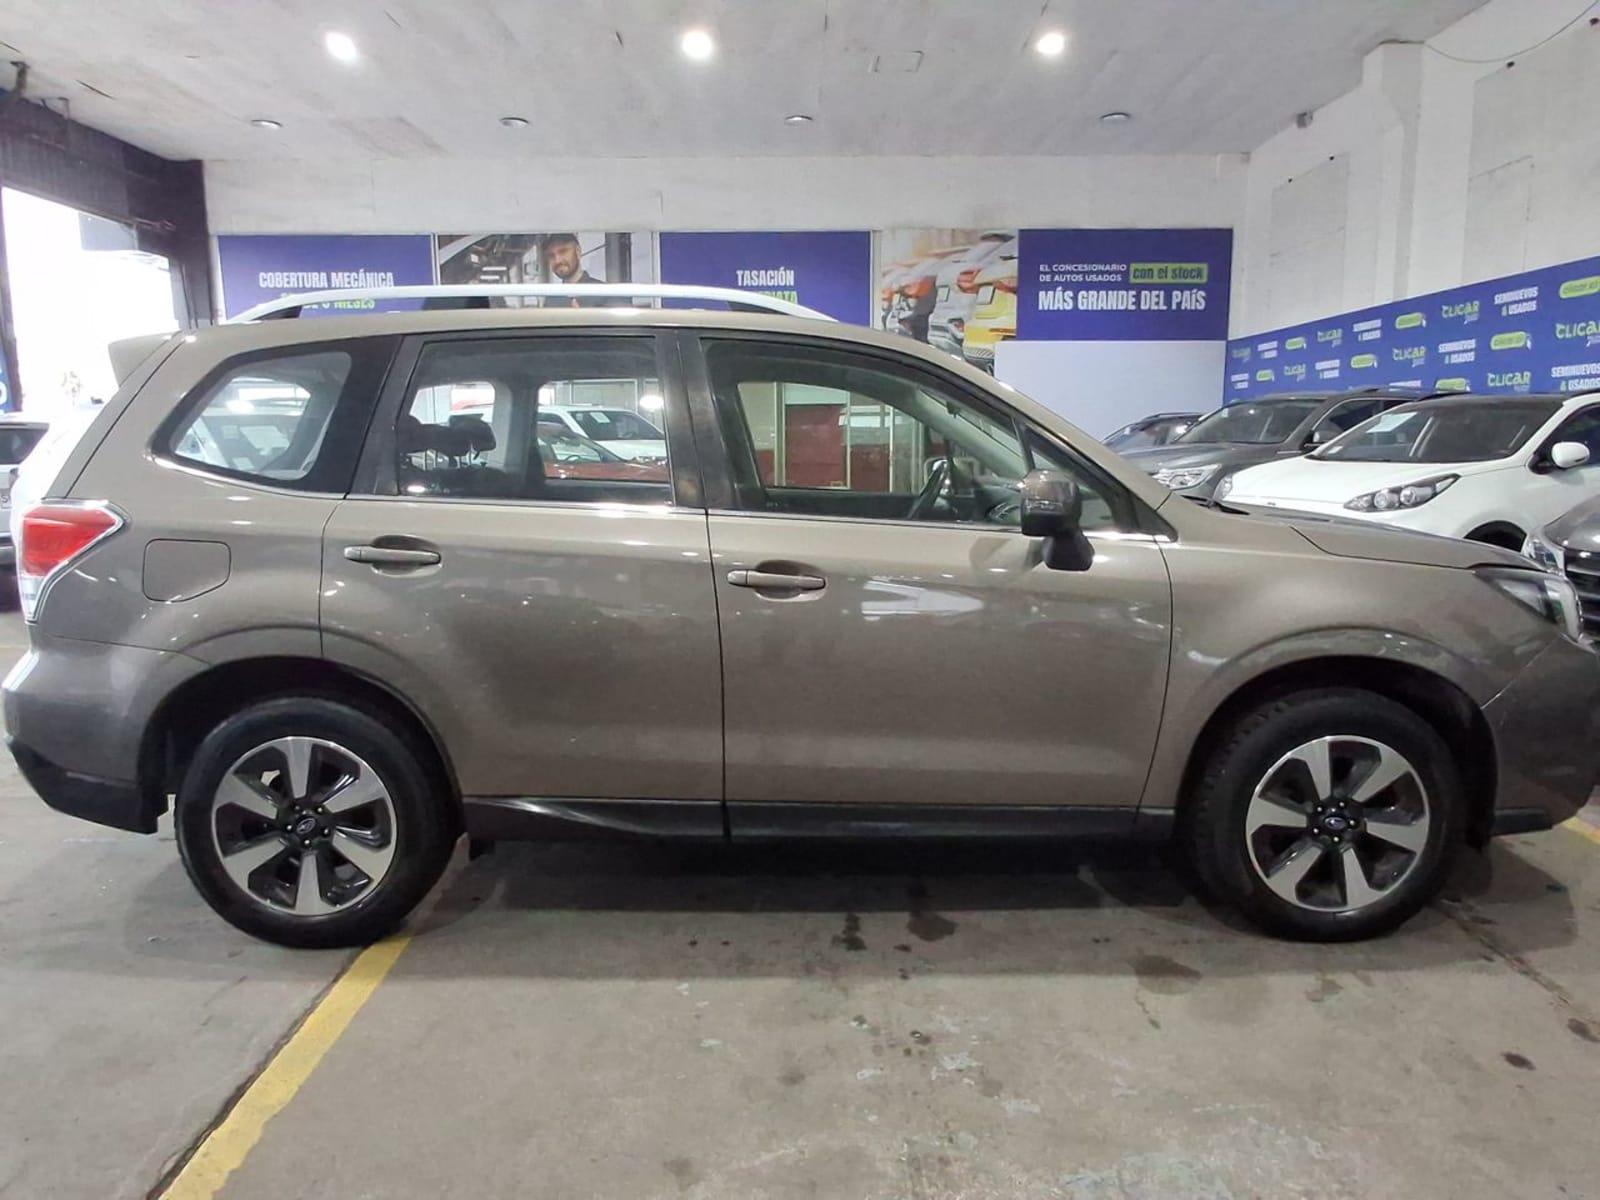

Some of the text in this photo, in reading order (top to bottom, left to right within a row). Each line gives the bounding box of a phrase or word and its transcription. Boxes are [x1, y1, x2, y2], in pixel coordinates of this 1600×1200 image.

[259, 269, 394, 288] COBERTURA MECÁNICA
[736, 266, 794, 286] TASACIÓN
[1039, 274, 1122, 282] DE AUTOS USADOS
[1133, 266, 1204, 279] con el stock
[1038, 287, 1206, 310] MÁS GRANDE DEL PAÍS
